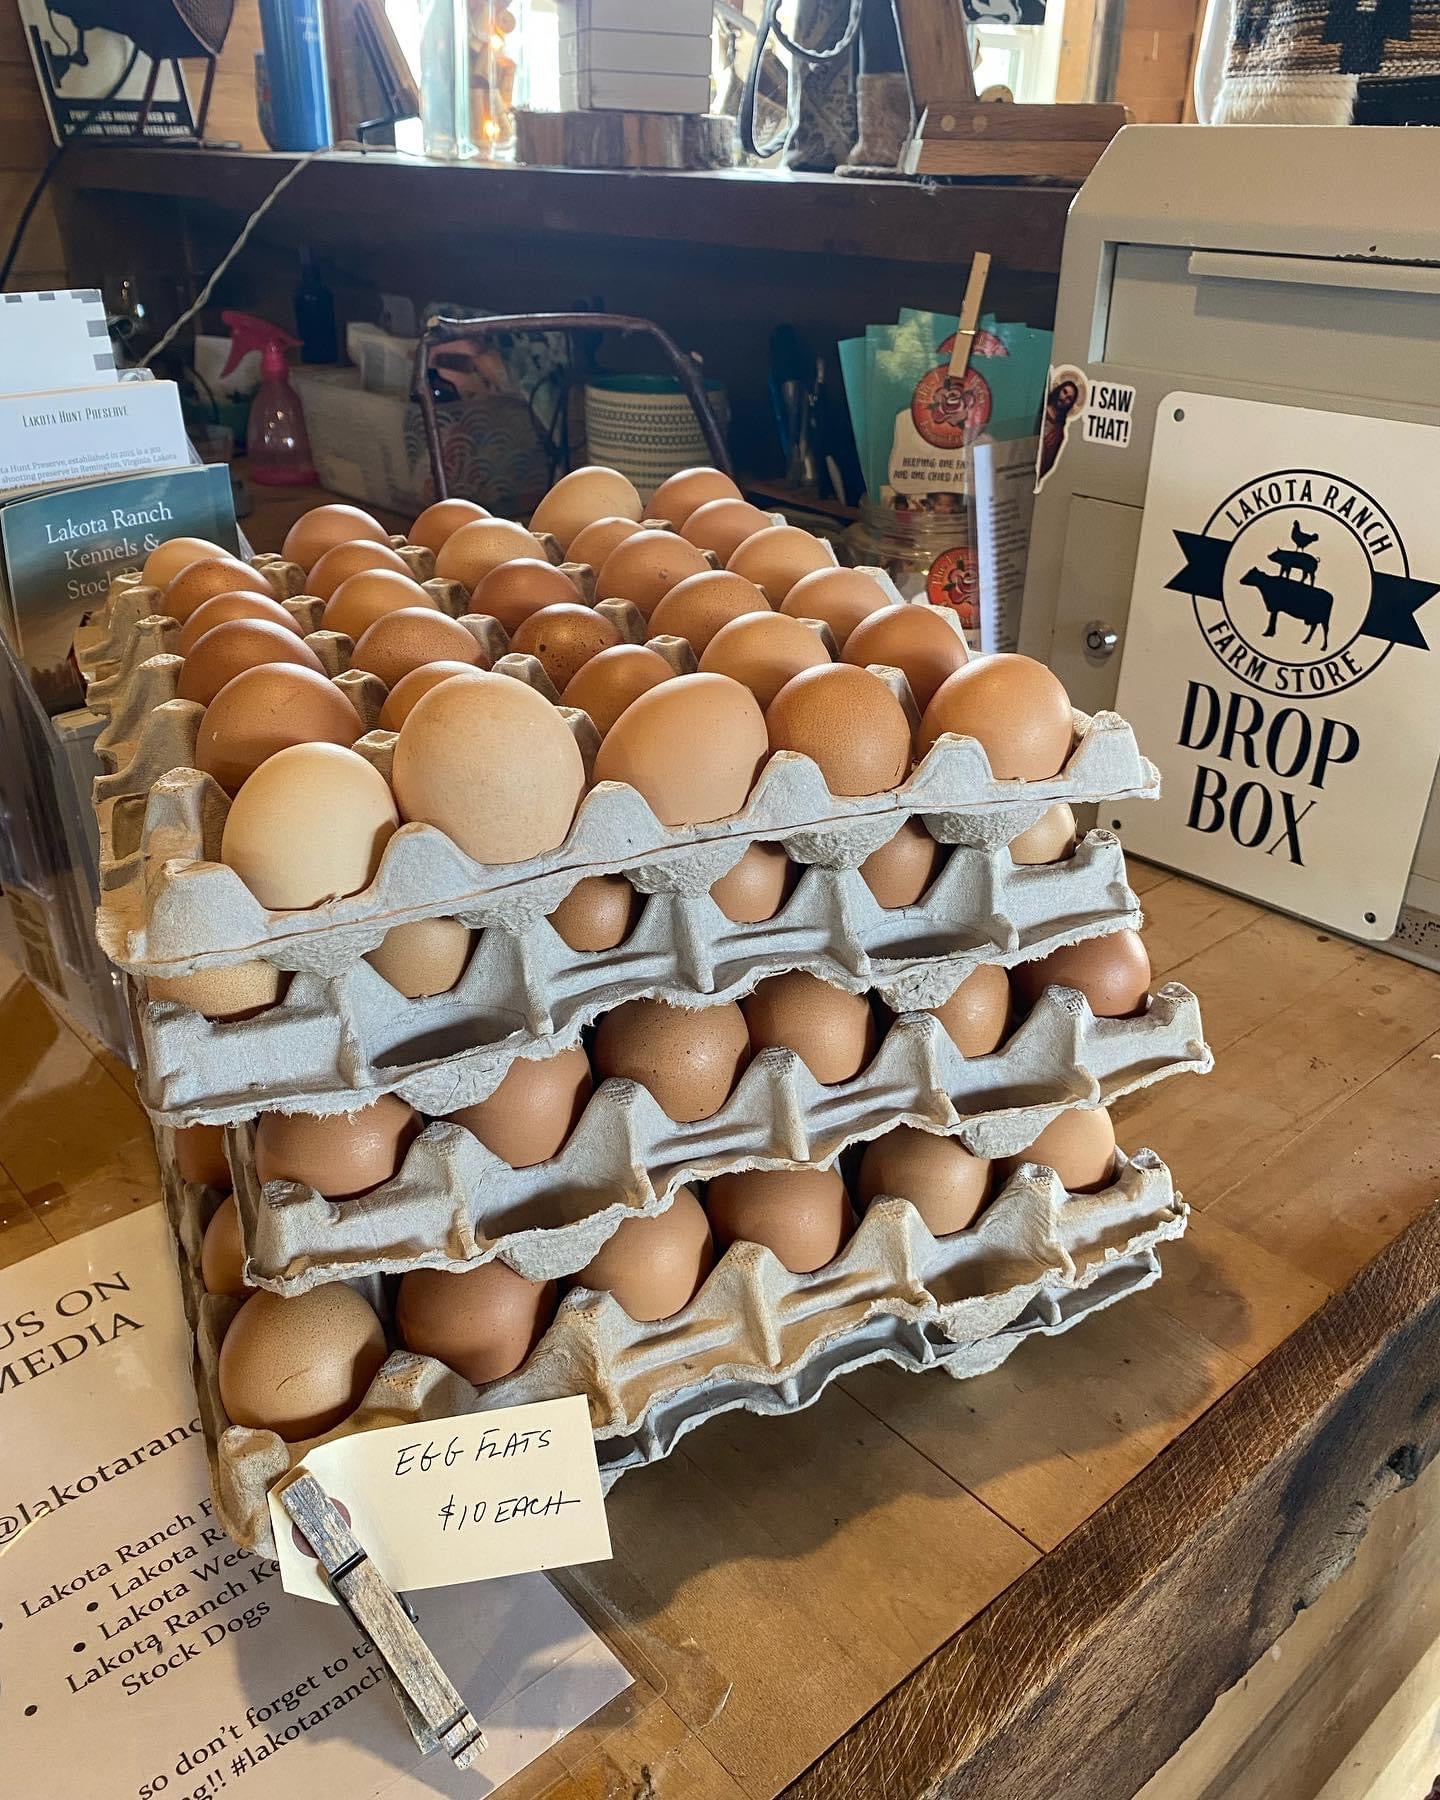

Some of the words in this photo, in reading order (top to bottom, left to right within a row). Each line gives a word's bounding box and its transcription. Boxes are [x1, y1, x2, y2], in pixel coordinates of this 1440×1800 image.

[1087, 415, 1129, 443] THAT!
[1091, 386, 1096, 407] I
[1100, 387, 1133, 413] SAW
[45, 516, 109, 545] Lakota
[111, 501, 174, 530] Ranch
[1225, 480, 1313, 528] LAKOTA
[1323, 484, 1393, 557] RANCH
[64, 537, 139, 570] Kennels
[143, 533, 160, 552] &
[1207, 619, 1266, 683] FARM
[1275, 650, 1363, 693] STORE
[1176, 680, 1360, 791] DROP
[1186, 765, 1318, 867] BOX
[55, 1271, 132, 1318] ON
[394, 1436, 465, 1476] EGG
[475, 1428, 552, 1462] FLATS
[437, 1493, 487, 1531] $10
[494, 1490, 581, 1524] EACH
[19, 1561, 113, 1619] Lakota
[114, 1514, 197, 1566] Ranch
[108, 1541, 199, 1601] Lakota
[65, 1634, 160, 1694] Lakota
[163, 1581, 249, 1637] Ranch
[97, 1582, 191, 1642] Lakota
[121, 1642, 201, 1697] Stock
[201, 1600, 271, 1648] Dogs
[138, 1774, 168, 1800] so
[245, 1675, 320, 1730] forget
[322, 1655, 349, 1680] to
